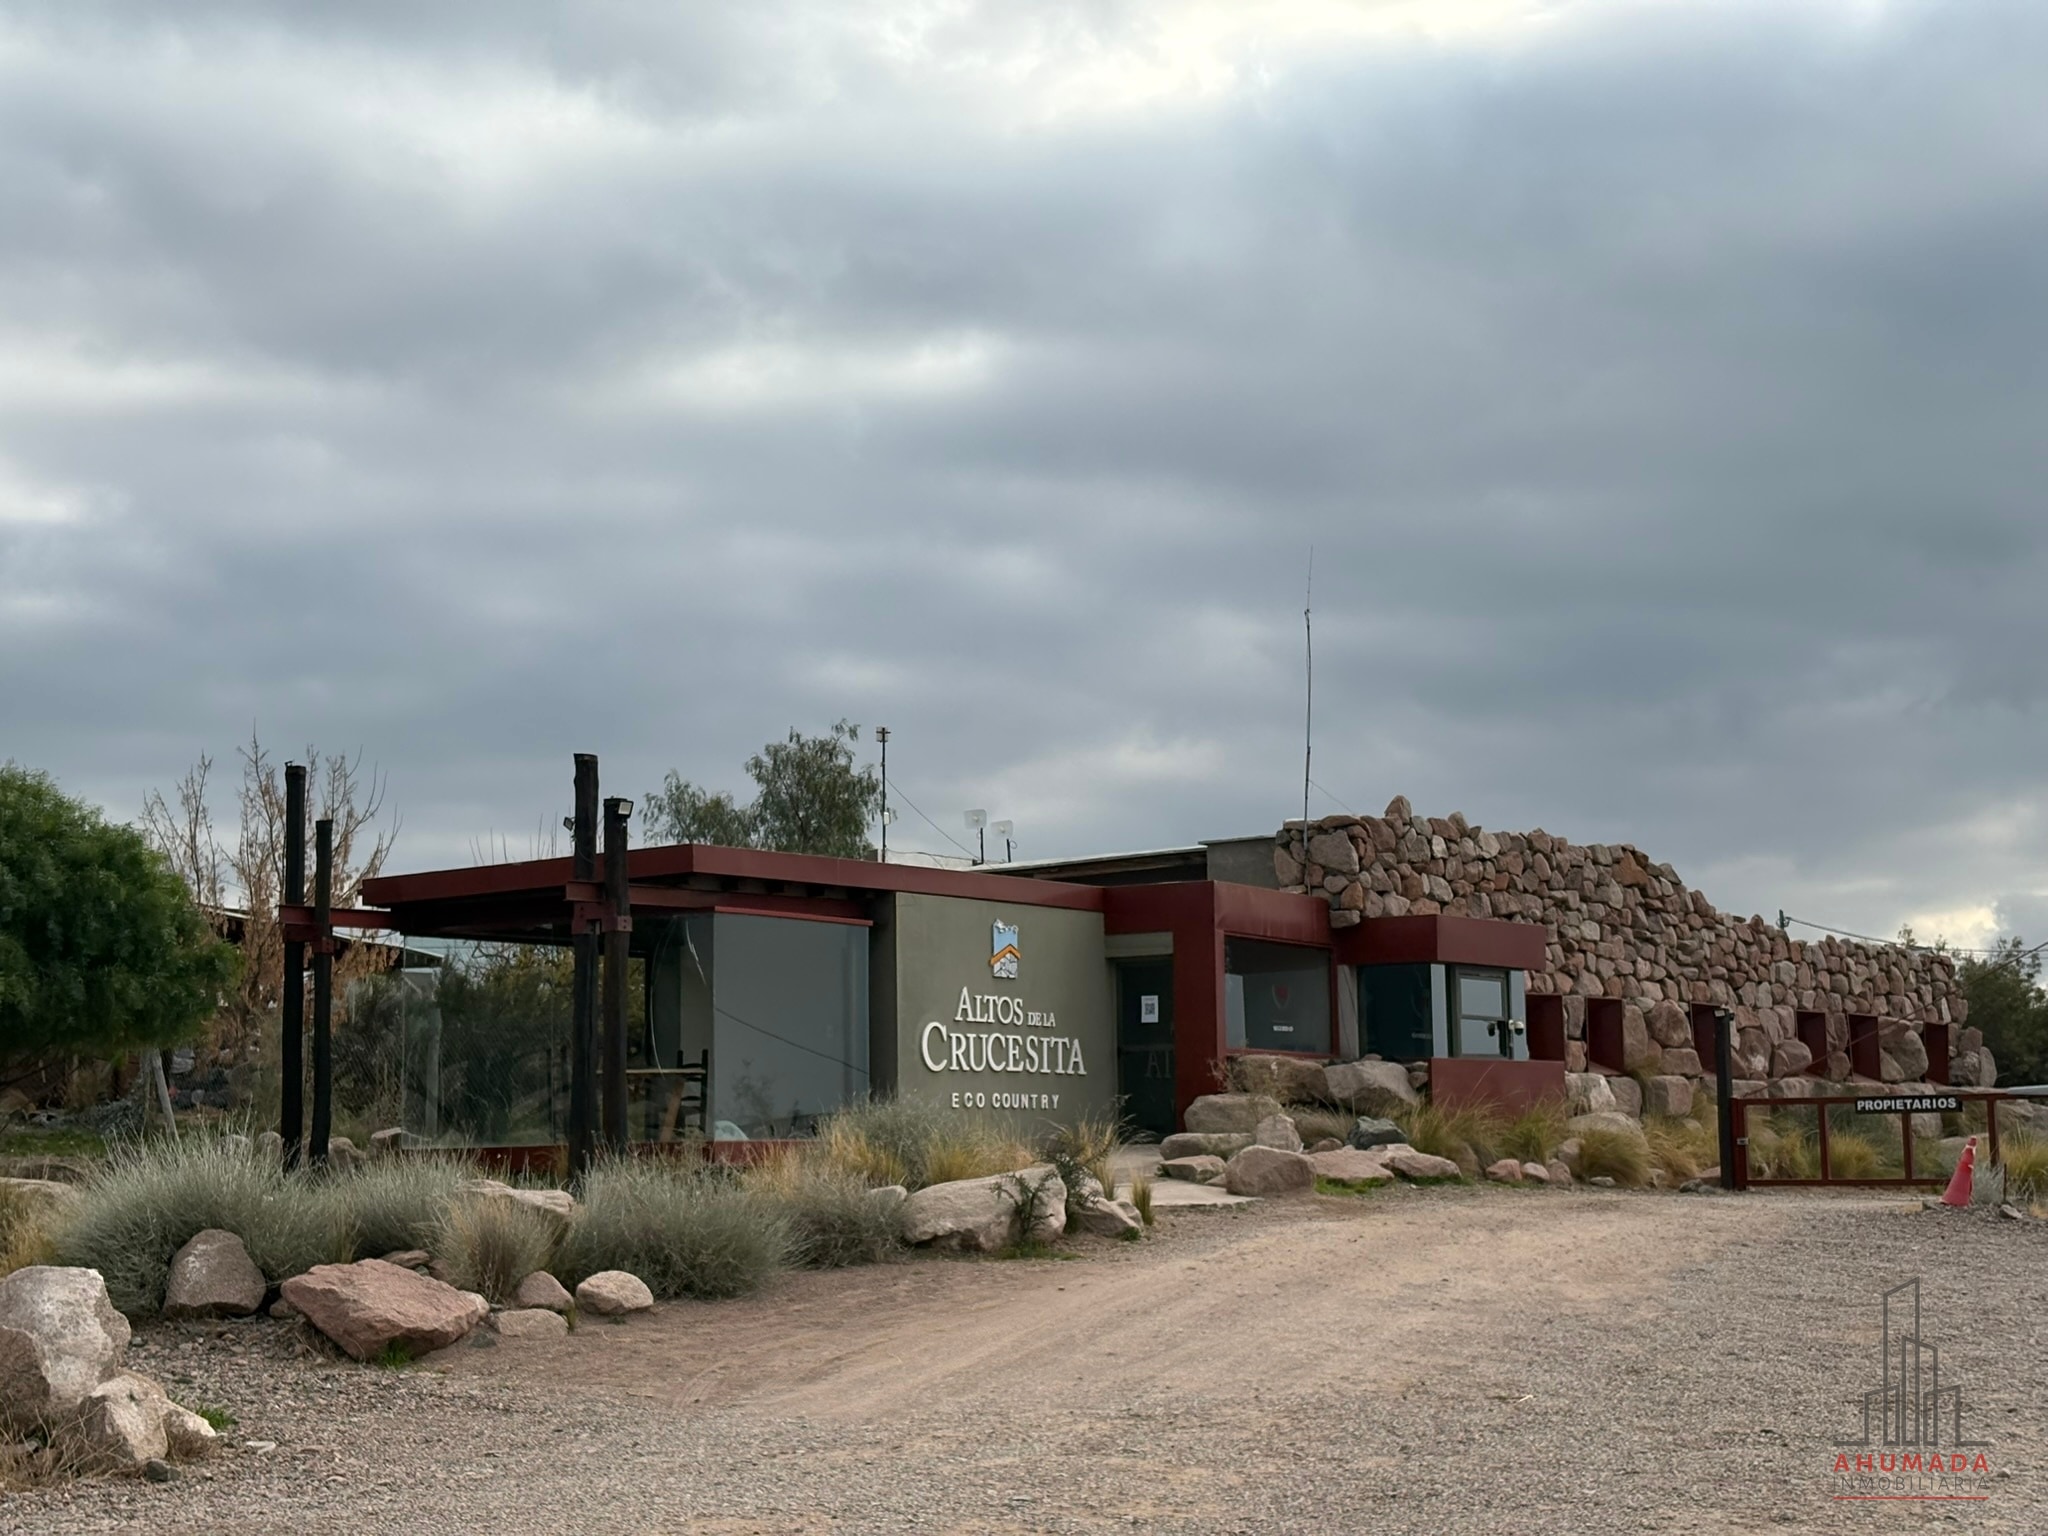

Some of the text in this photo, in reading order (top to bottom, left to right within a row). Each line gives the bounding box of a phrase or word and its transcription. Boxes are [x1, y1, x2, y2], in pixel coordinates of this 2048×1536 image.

[954, 985, 1056, 1028] ALTOS DE LA
[921, 1021, 1087, 1075] CRUCESITA
[951, 1092, 1060, 1110] ECO COUNTRY
[1856, 1097, 1957, 1112] PROPIETARIOS
